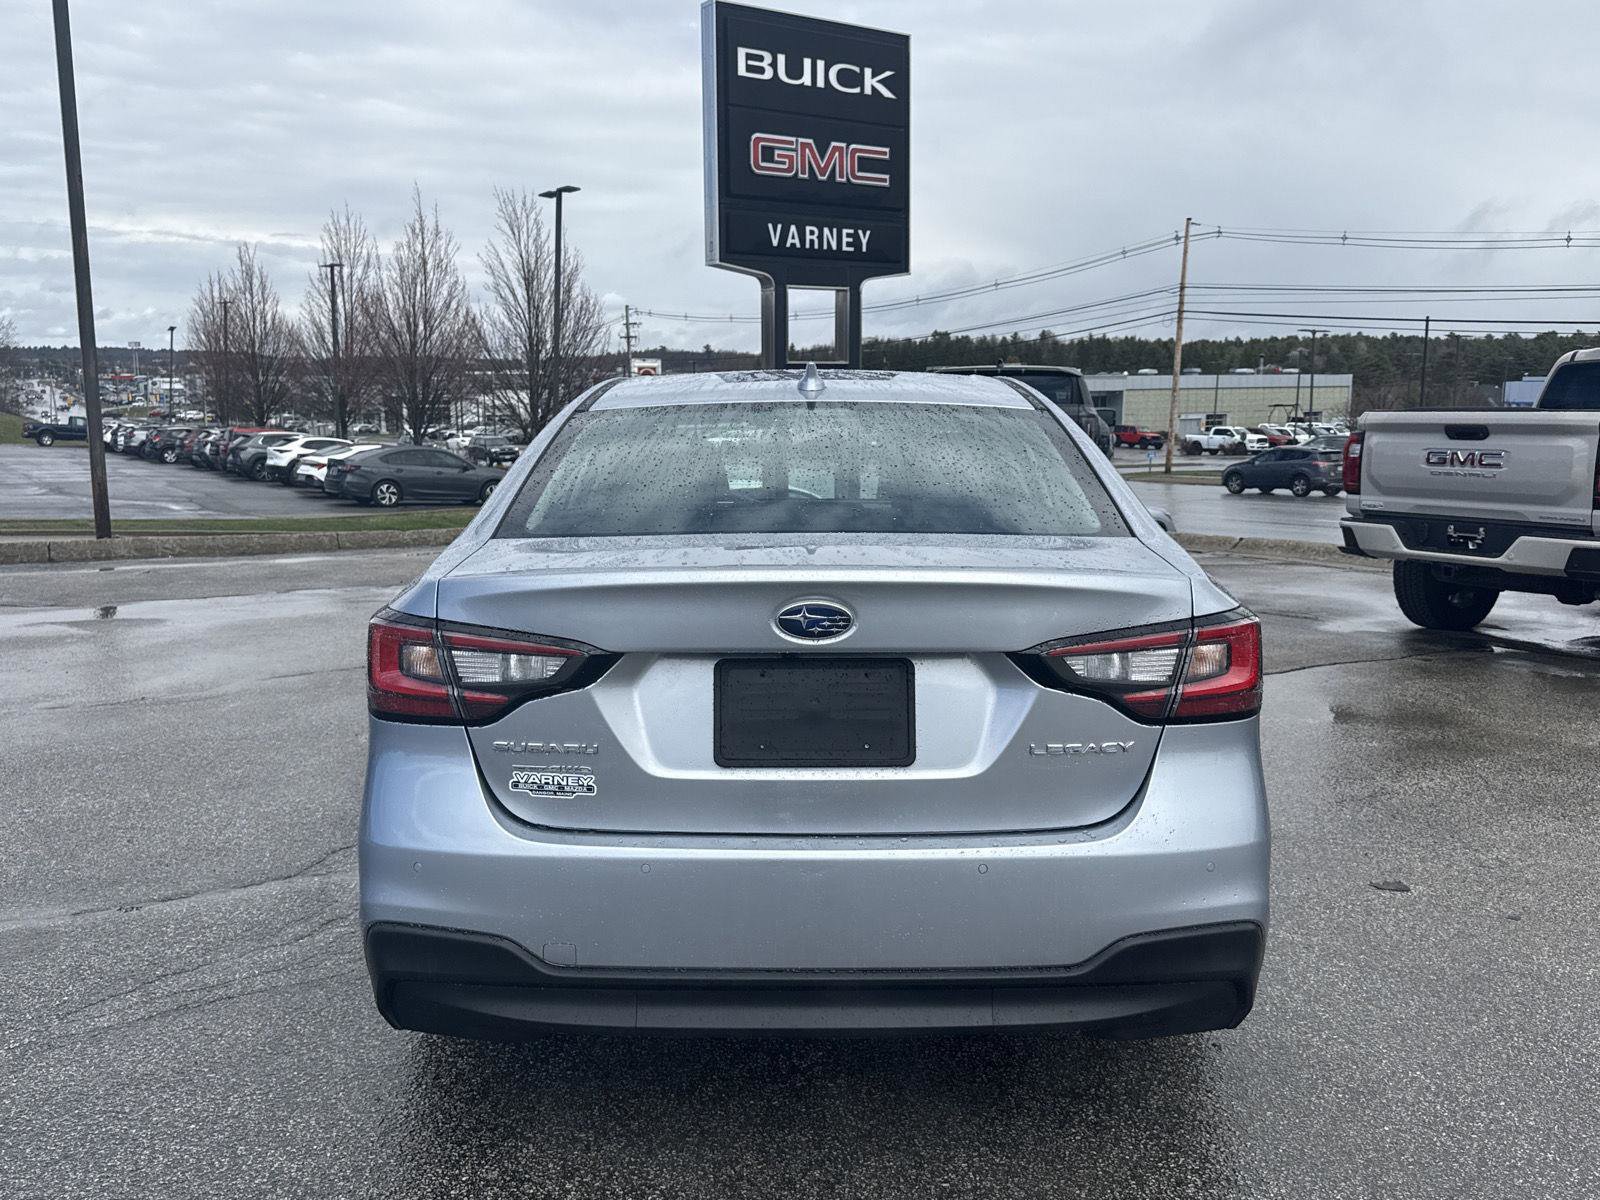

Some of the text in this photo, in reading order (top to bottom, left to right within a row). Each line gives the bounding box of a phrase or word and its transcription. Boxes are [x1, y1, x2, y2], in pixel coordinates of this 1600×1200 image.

[737, 46, 897, 99] BUICK
[751, 132, 890, 187] GMC
[767, 223, 871, 252] VARNEY
[1425, 449, 1505, 468] GMC
[492, 740, 599, 755] SUBARU
[1029, 740, 1135, 756] LEGACY
[513, 773, 594, 787] VARNEY
